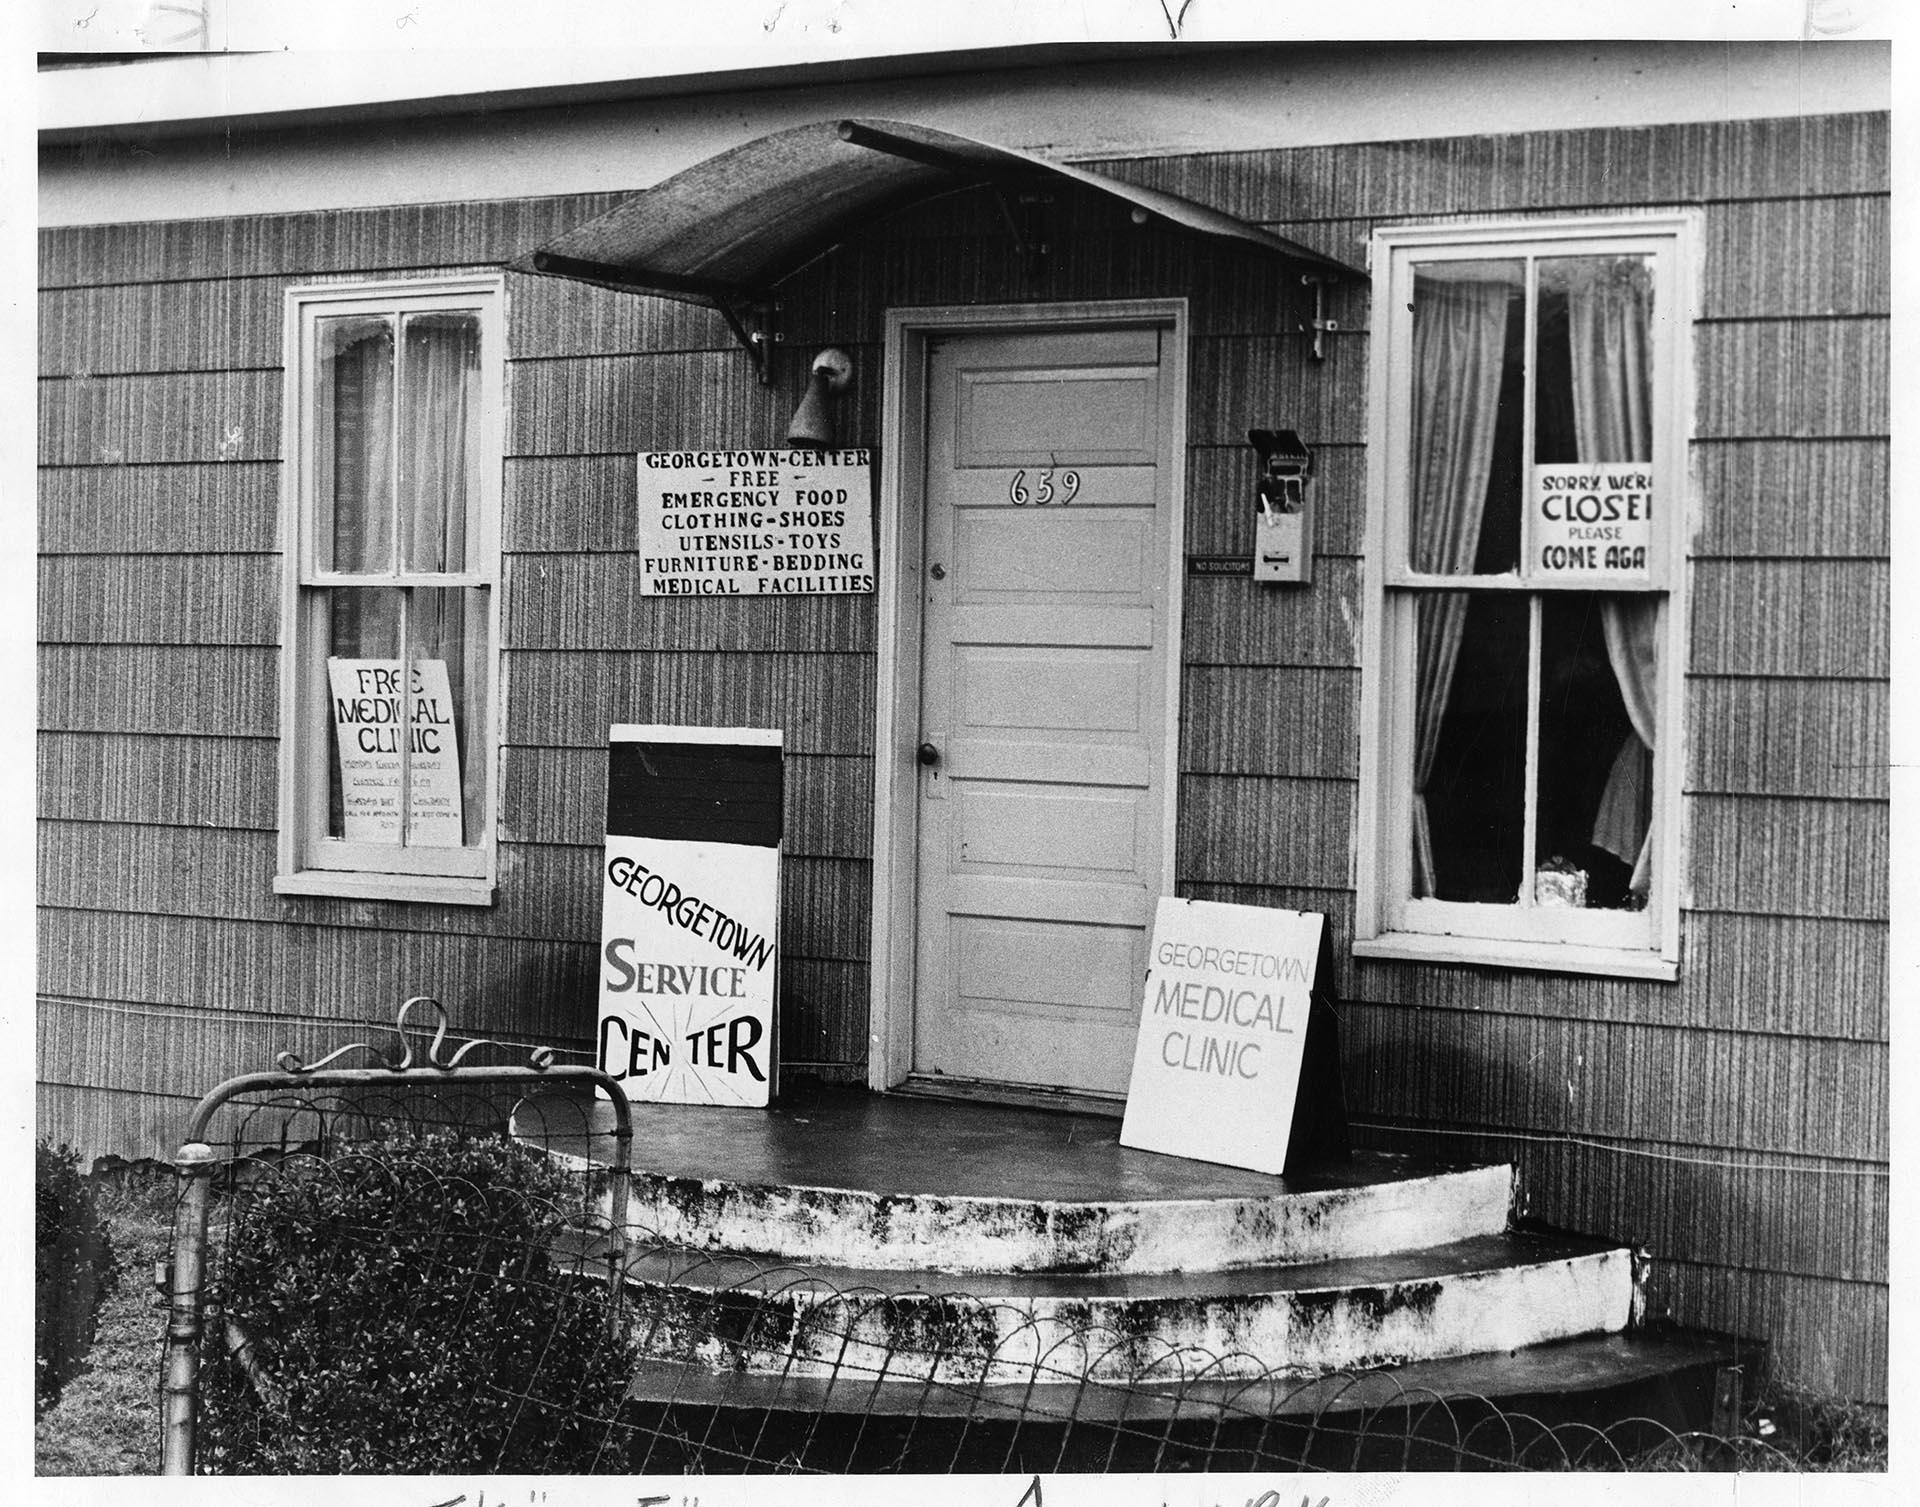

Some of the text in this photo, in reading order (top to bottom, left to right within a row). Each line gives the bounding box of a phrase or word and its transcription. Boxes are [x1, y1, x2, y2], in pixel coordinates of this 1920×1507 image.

[645, 451, 870, 469] GEORGETOWN-CENTER
[730, 471, 780, 487] FREE
[1010, 470, 1080, 505] 659
[1542, 475, 1601, 491] SORRY
[661, 489, 848, 509] EMERGENCY FOOD
[1568, 526, 1623, 541] PLEASE
[1542, 545, 1646, 570] COME AGA
[653, 574, 874, 595] MEDICAL FACILITIES
[356, 668, 425, 695] FREE
[608, 856, 775, 972] GEORGETOWN
[605, 938, 747, 998] SERVICE
[1157, 942, 1310, 983] GEORGETOWN
[1154, 979, 1294, 1034] MEDICAL
[1162, 1031, 1262, 1080] CLINIC
